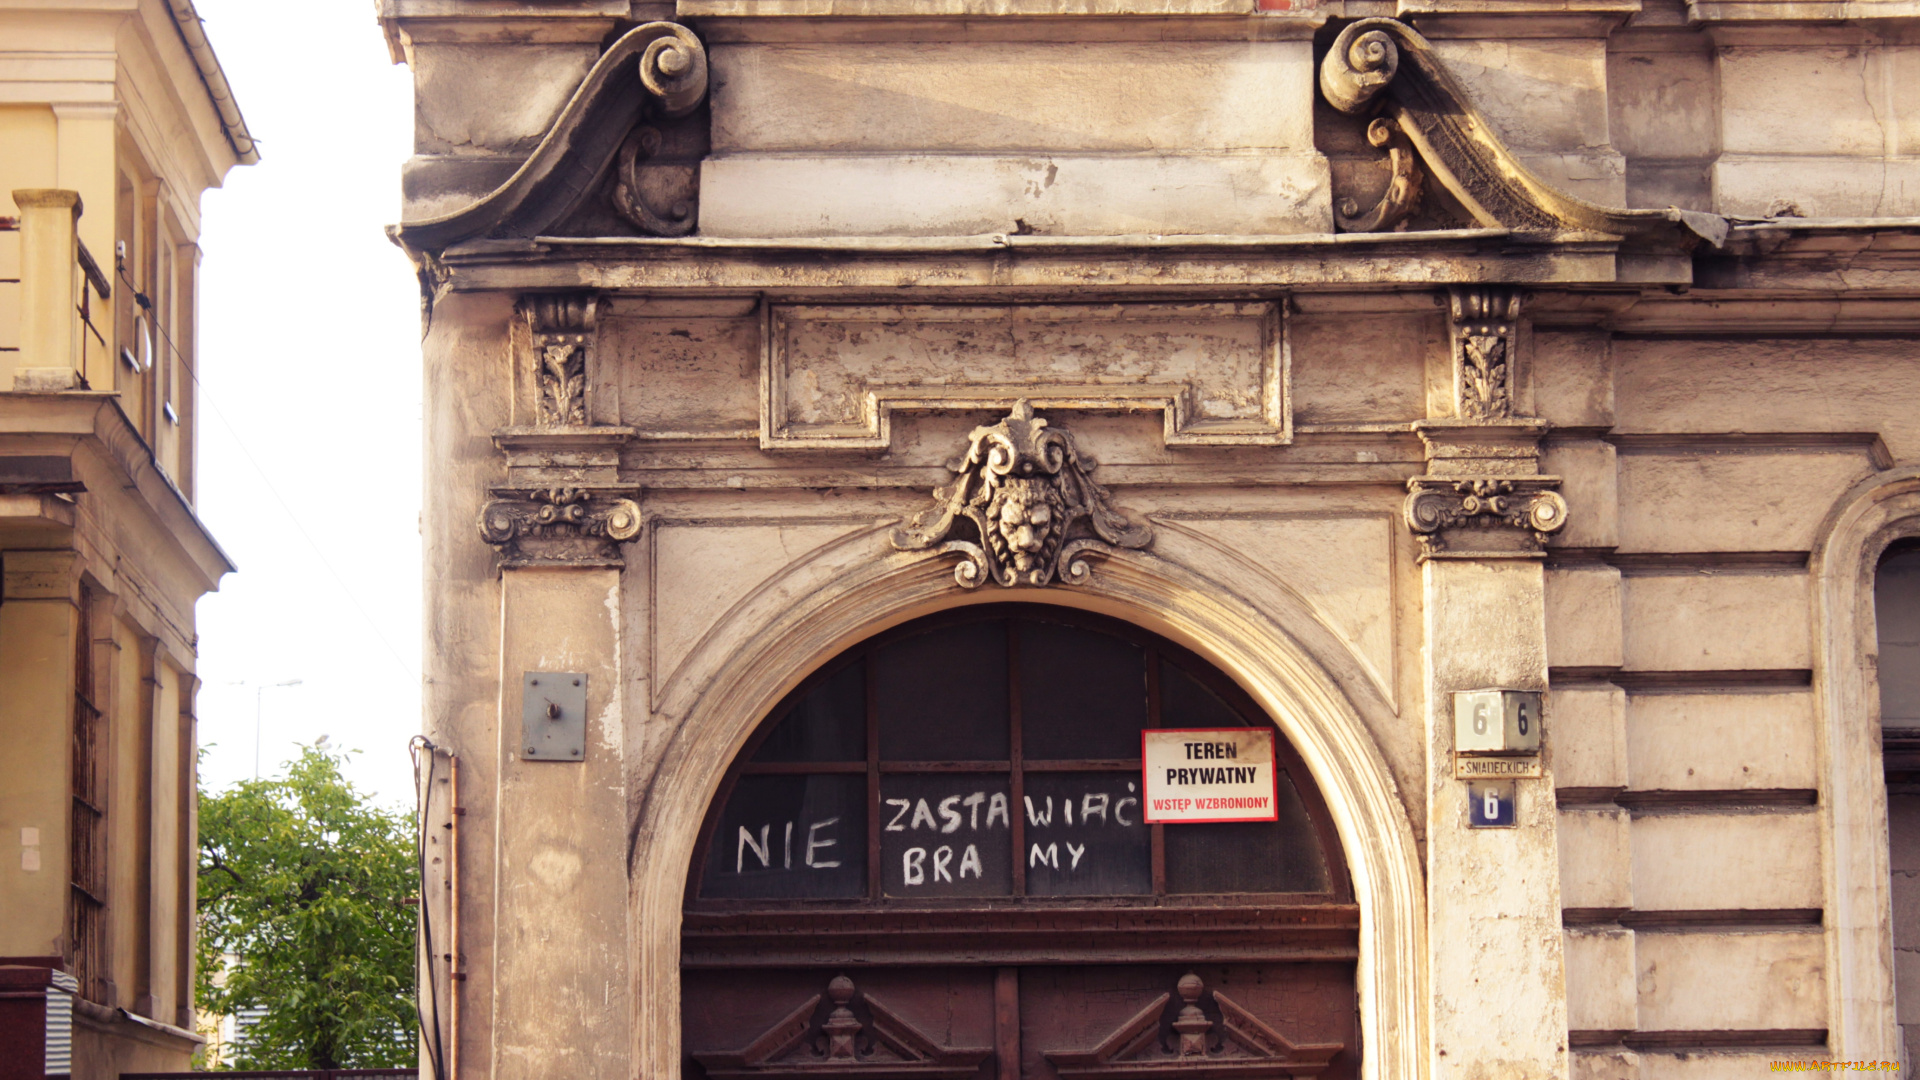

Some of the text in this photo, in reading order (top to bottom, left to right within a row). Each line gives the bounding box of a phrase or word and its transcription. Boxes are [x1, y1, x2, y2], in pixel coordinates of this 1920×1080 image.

[1473, 702, 1488, 736] 6
[1517, 702, 1529, 736] 6
[1184, 742, 1238, 760] TEREN
[1166, 766, 1257, 786] PRYWATNY
[1153, 796, 1269, 813] WSTĘP WZBRONIONY
[1484, 787, 1499, 820] 6
[737, 817, 841, 874] NIE
